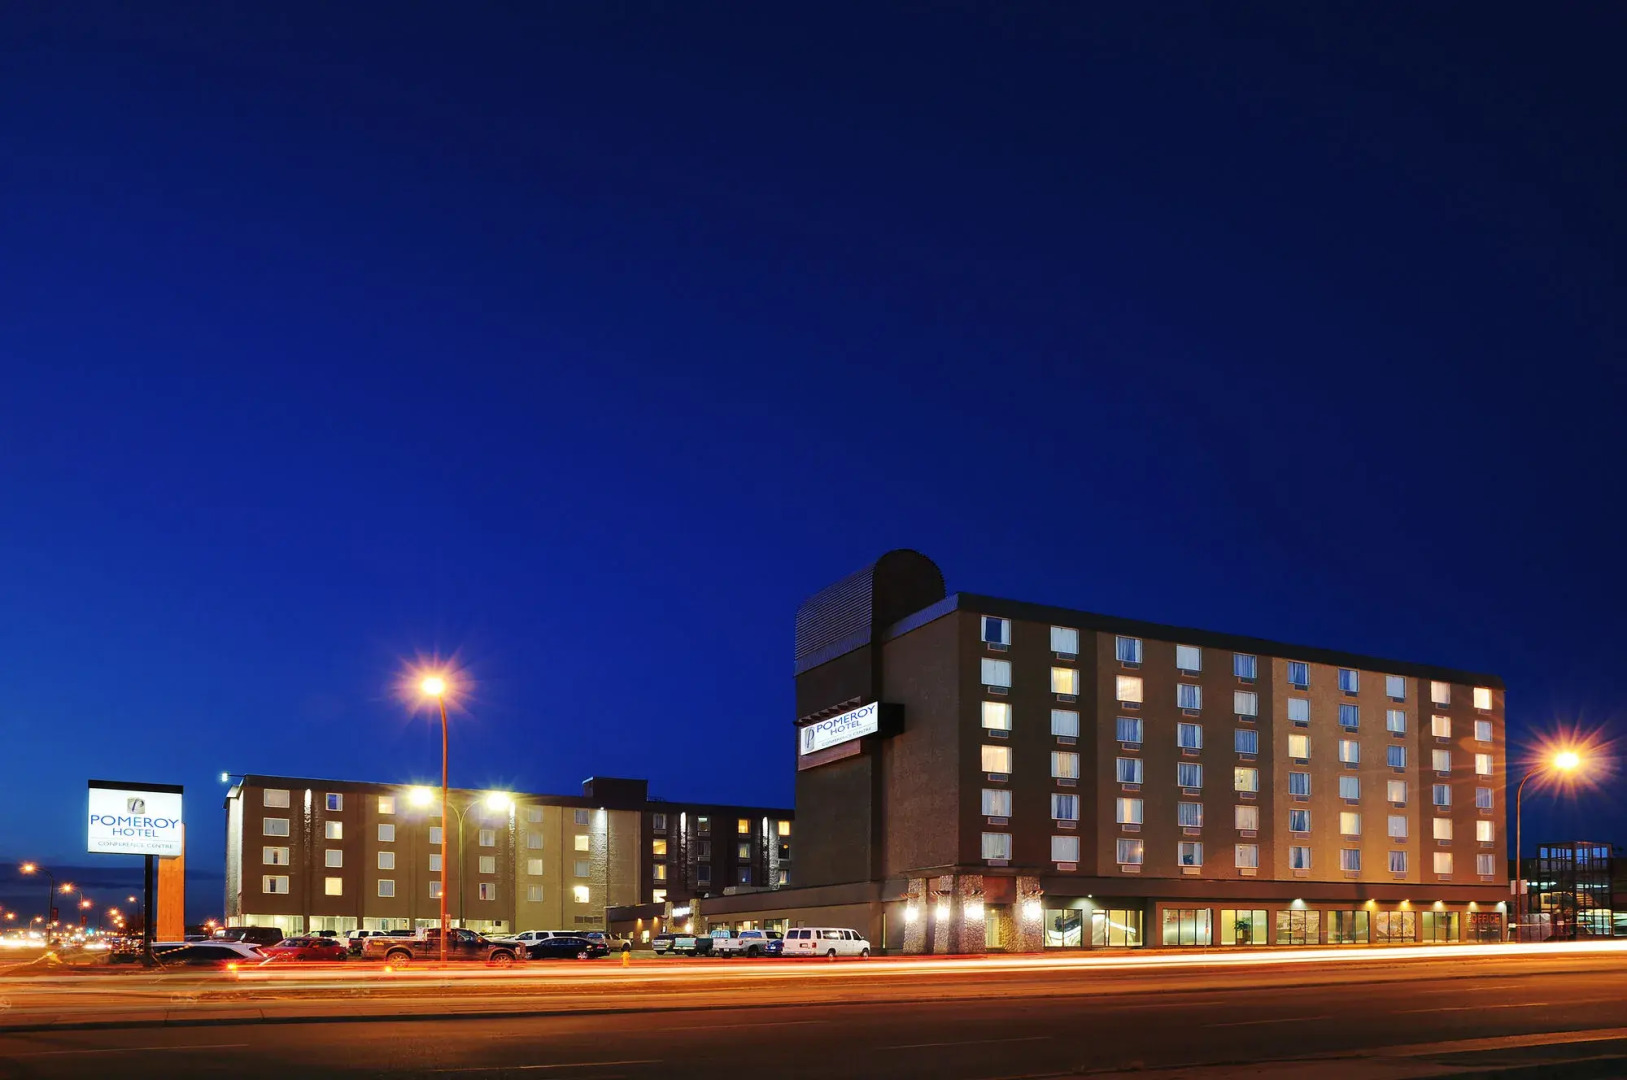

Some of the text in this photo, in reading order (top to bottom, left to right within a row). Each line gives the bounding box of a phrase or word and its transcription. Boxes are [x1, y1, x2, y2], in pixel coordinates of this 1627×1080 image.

[816, 705, 875, 733] POMEROY
[830, 720, 862, 735] HOTEL
[90, 814, 179, 829] POMEROY
[112, 827, 159, 838] HOTEL
